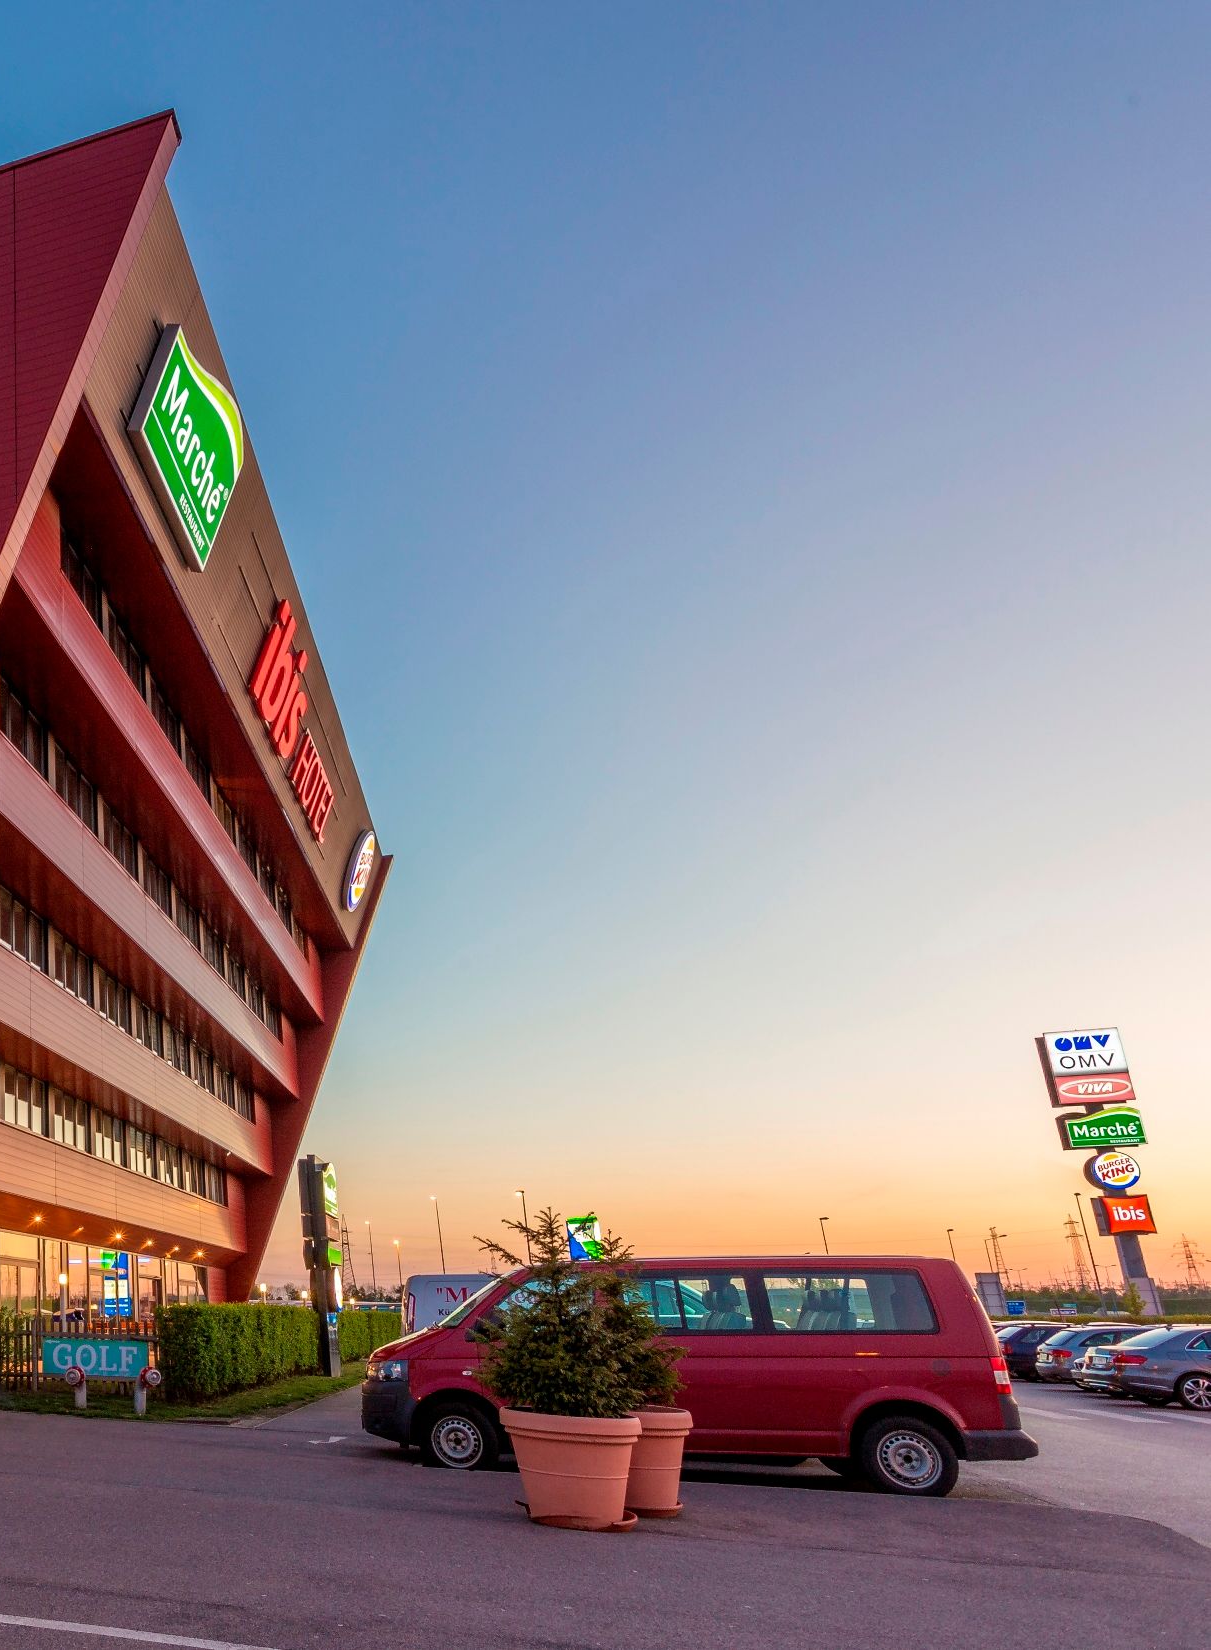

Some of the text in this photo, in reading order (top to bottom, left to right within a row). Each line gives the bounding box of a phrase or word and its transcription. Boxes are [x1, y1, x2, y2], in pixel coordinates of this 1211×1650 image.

[179, 492, 205, 551] RESTAURANT
[250, 598, 335, 844] ibis HOTEL
[1059, 1052, 1115, 1069] OMV
[1077, 1082, 1113, 1094] VIVA
[1097, 1157, 1131, 1173] BURGER
[1101, 1163, 1135, 1182] KING
[1112, 1205, 1146, 1221] ibis
[52, 1343, 138, 1373] GOLF
